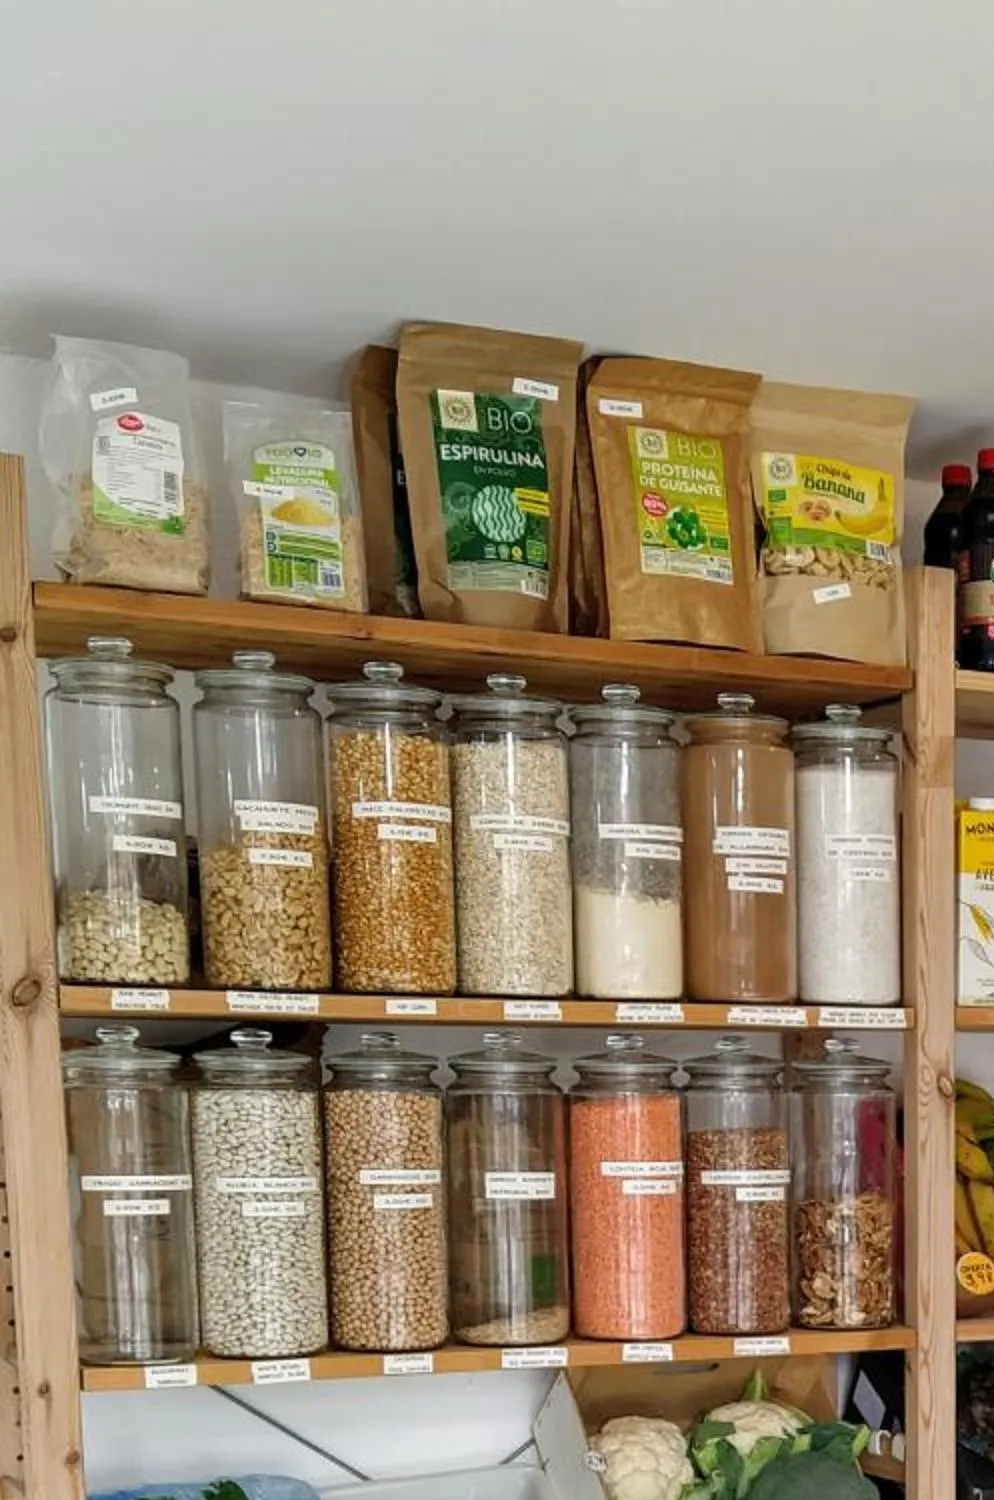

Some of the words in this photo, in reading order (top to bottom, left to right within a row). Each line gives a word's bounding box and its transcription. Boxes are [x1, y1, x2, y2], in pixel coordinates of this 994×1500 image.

[486, 407, 533, 434] BIO
[439, 443, 545, 469] ESPIRULINA
[639, 475, 658, 489] DE
[659, 476, 722, 498] GUISANTE
[800, 472, 866, 505] Banana
